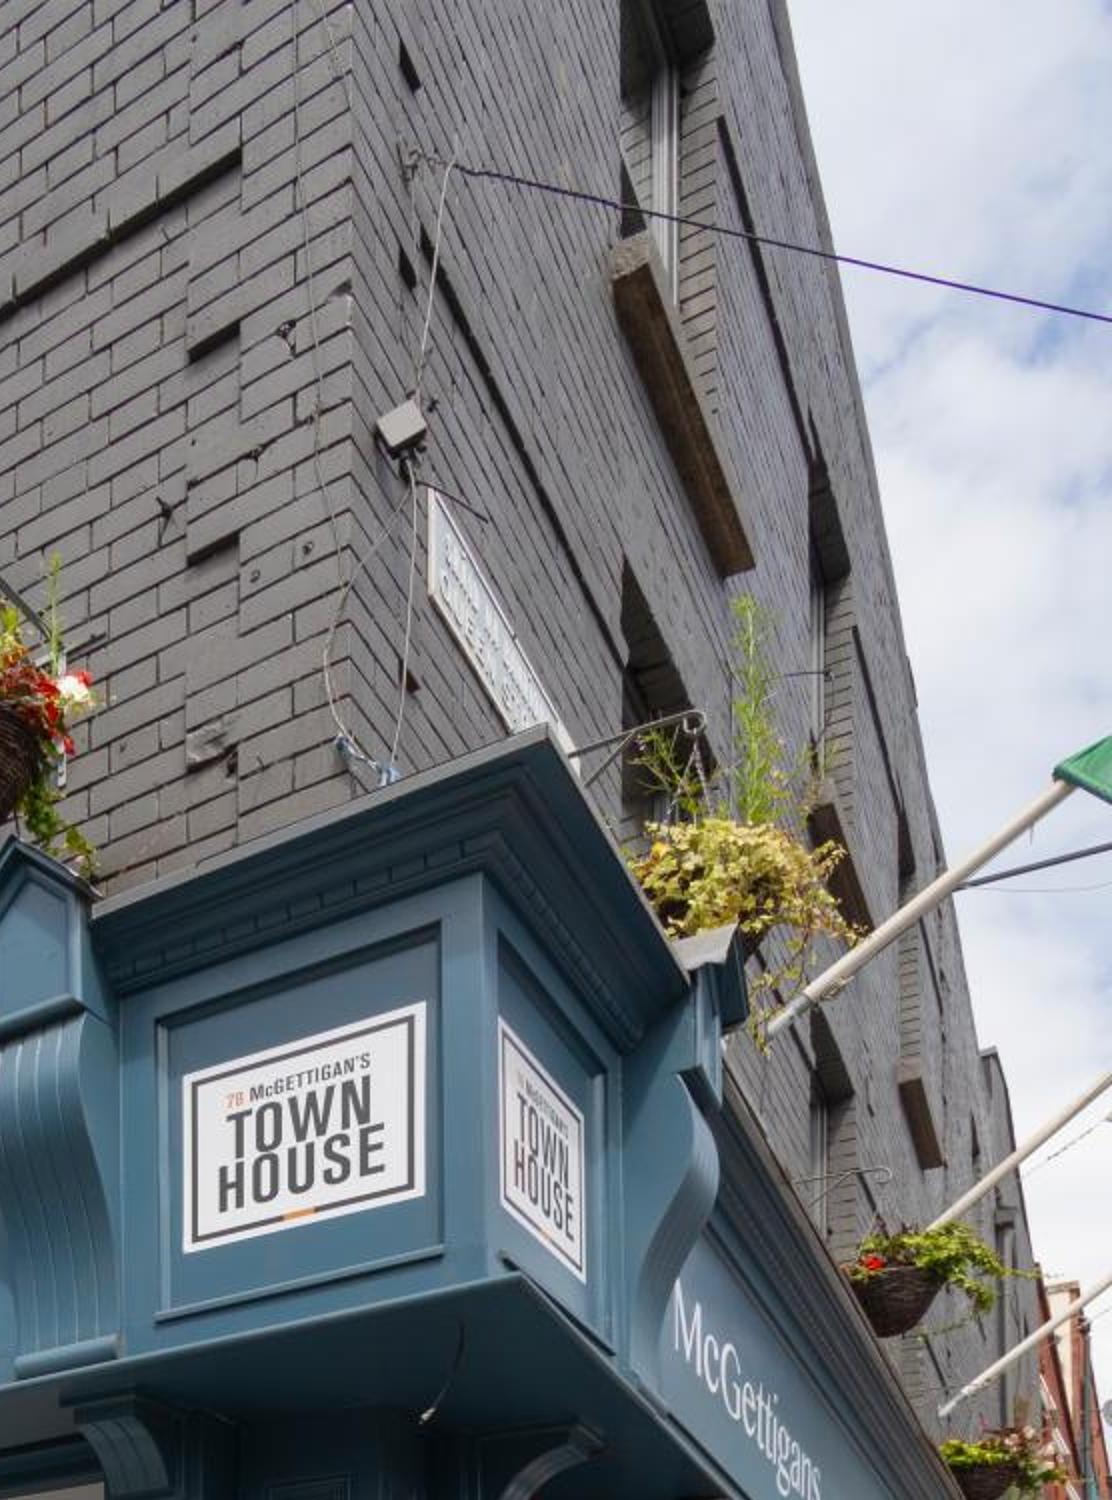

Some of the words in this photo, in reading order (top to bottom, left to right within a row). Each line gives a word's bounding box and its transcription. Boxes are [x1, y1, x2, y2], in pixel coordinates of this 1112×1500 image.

[226, 1074, 371, 1159] TOWN
[516, 1092, 569, 1190] TOWN
[219, 1122, 386, 1213] HOUSE
[514, 1139, 575, 1242] HOUSE
